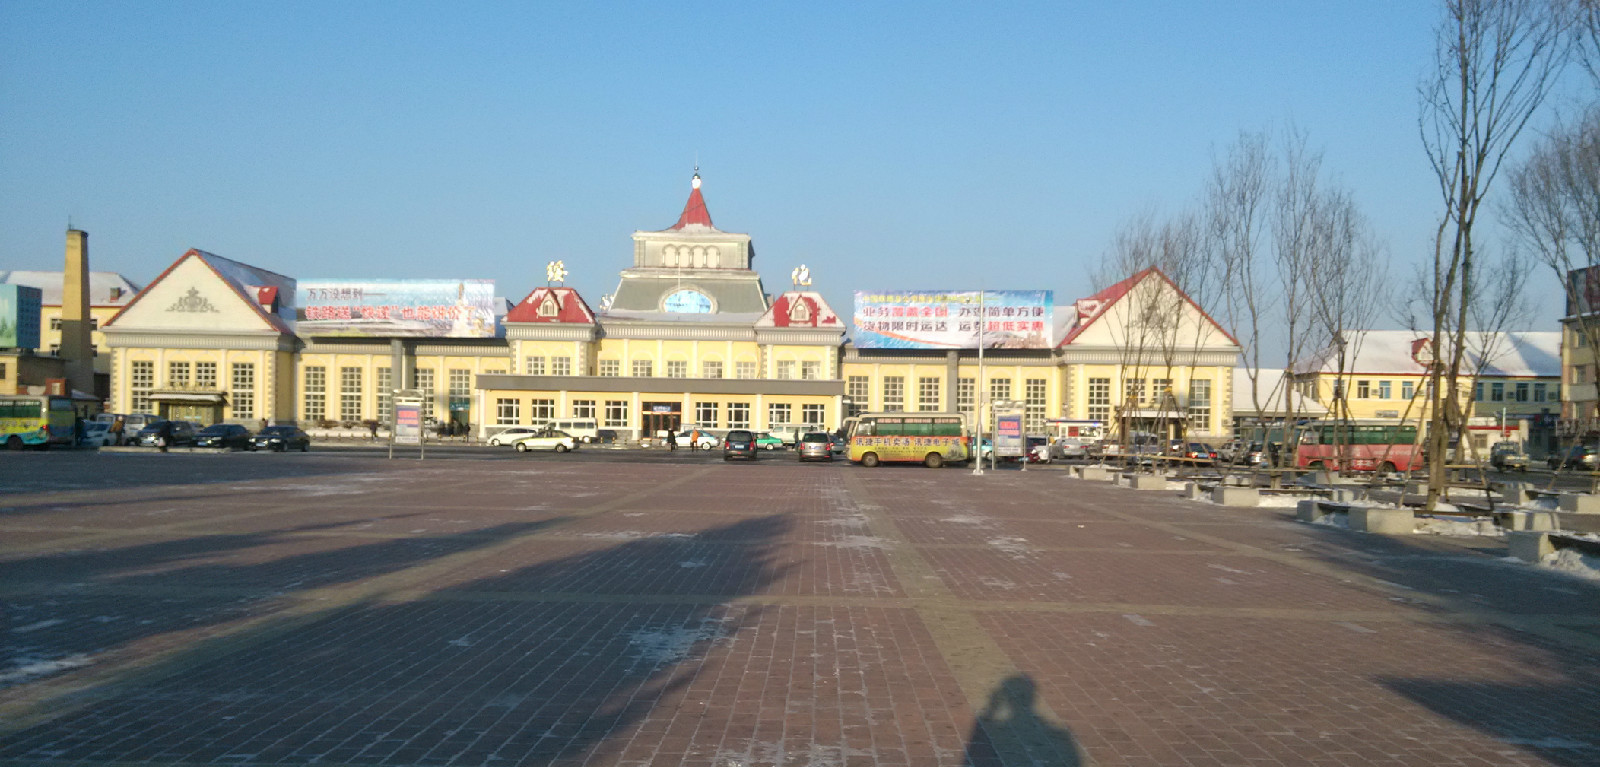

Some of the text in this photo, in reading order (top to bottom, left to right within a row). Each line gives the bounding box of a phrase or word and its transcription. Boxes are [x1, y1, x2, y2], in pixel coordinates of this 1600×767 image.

[863, 306, 1044, 318] 业务覆盖全国 办理简单方便
[863, 320, 948, 332] 货物限时运达
